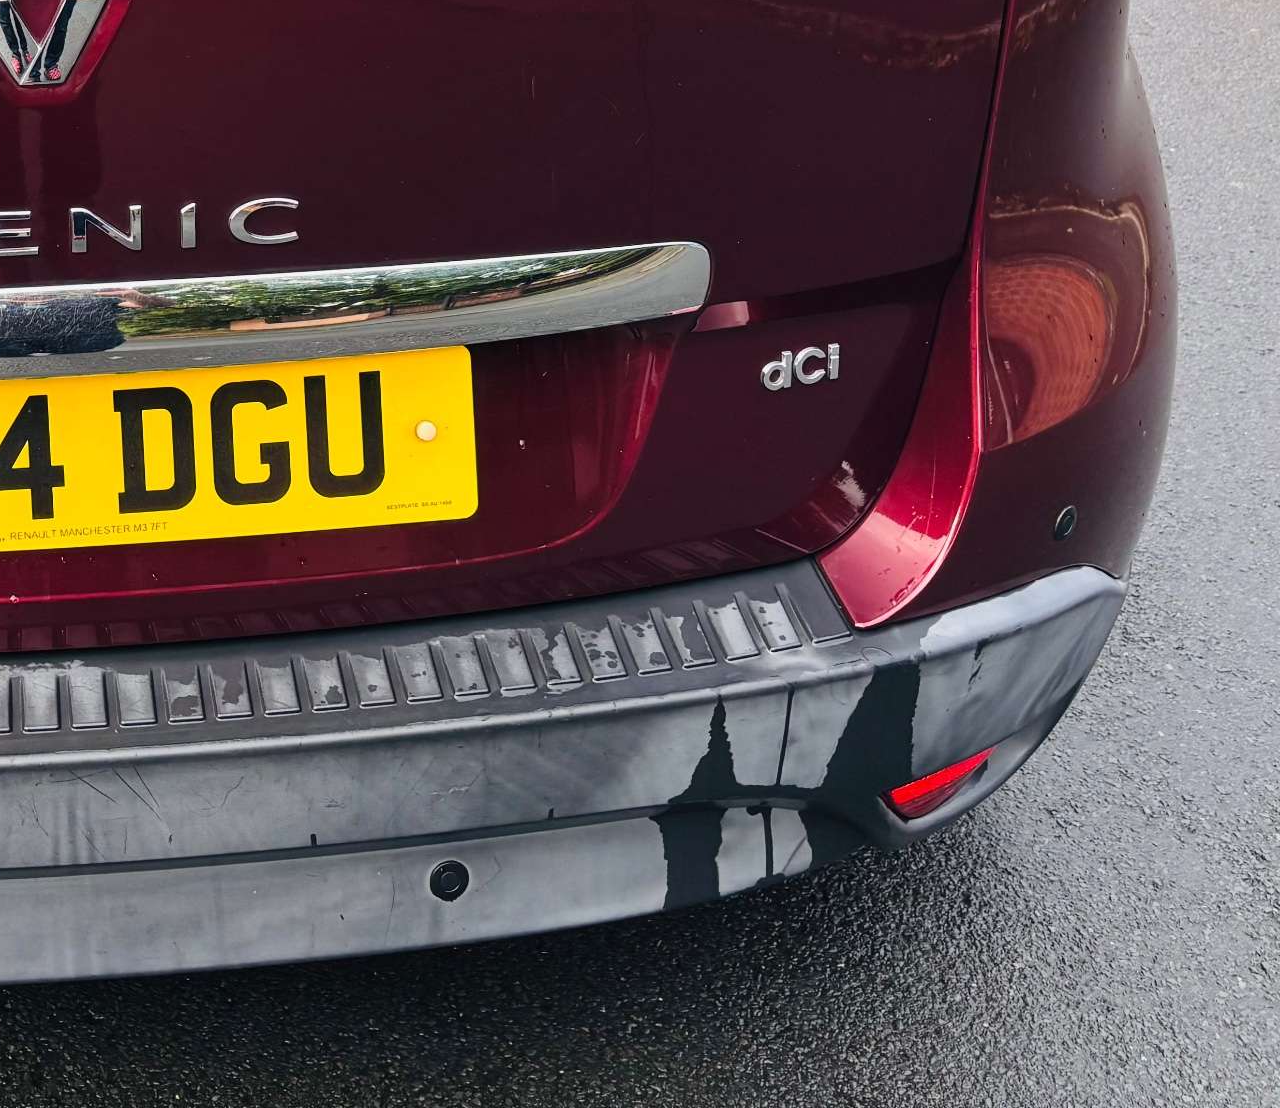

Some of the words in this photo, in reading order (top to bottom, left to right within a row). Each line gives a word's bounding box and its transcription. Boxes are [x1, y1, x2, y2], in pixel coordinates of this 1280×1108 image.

[761, 342, 840, 391] dCi
[113, 370, 385, 515] DGU
[10, 529, 57, 541] RENAULT
[60, 523, 130, 537] MANCHESTER
[133, 522, 148, 533] M3
